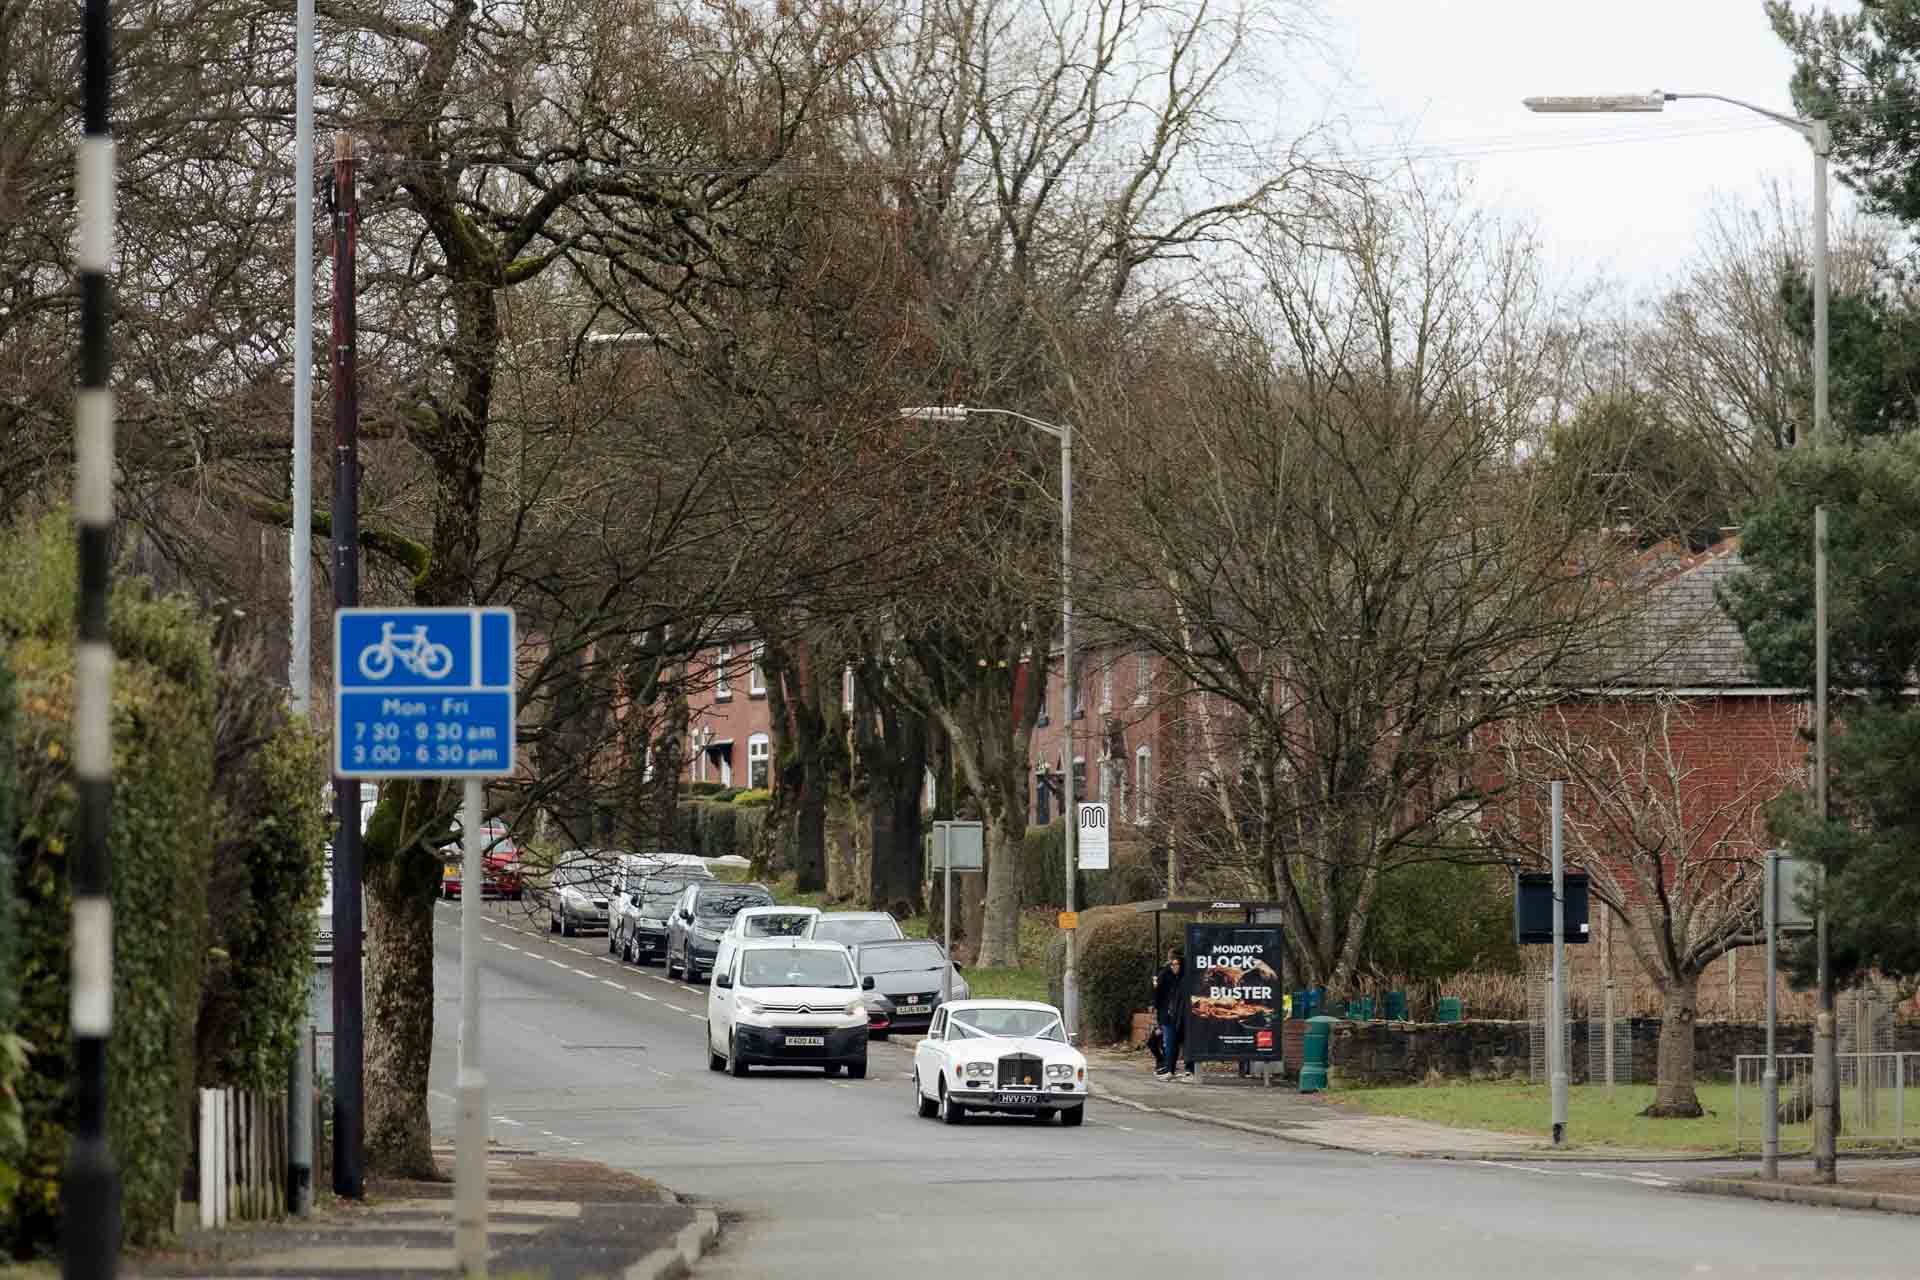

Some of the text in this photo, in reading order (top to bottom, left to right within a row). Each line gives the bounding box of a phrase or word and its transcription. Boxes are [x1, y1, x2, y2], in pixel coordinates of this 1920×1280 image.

[382, 698, 427, 716] Mon
[441, 697, 470, 716] Fri
[466, 725, 497, 741] am
[467, 748, 498, 765] pm
[1212, 944, 1264, 954] MONDAY'S
[1196, 955, 1254, 969] BLOCK
[1210, 986, 1272, 999] BUSTER
[1002, 1095, 1038, 1104] HVV 570
